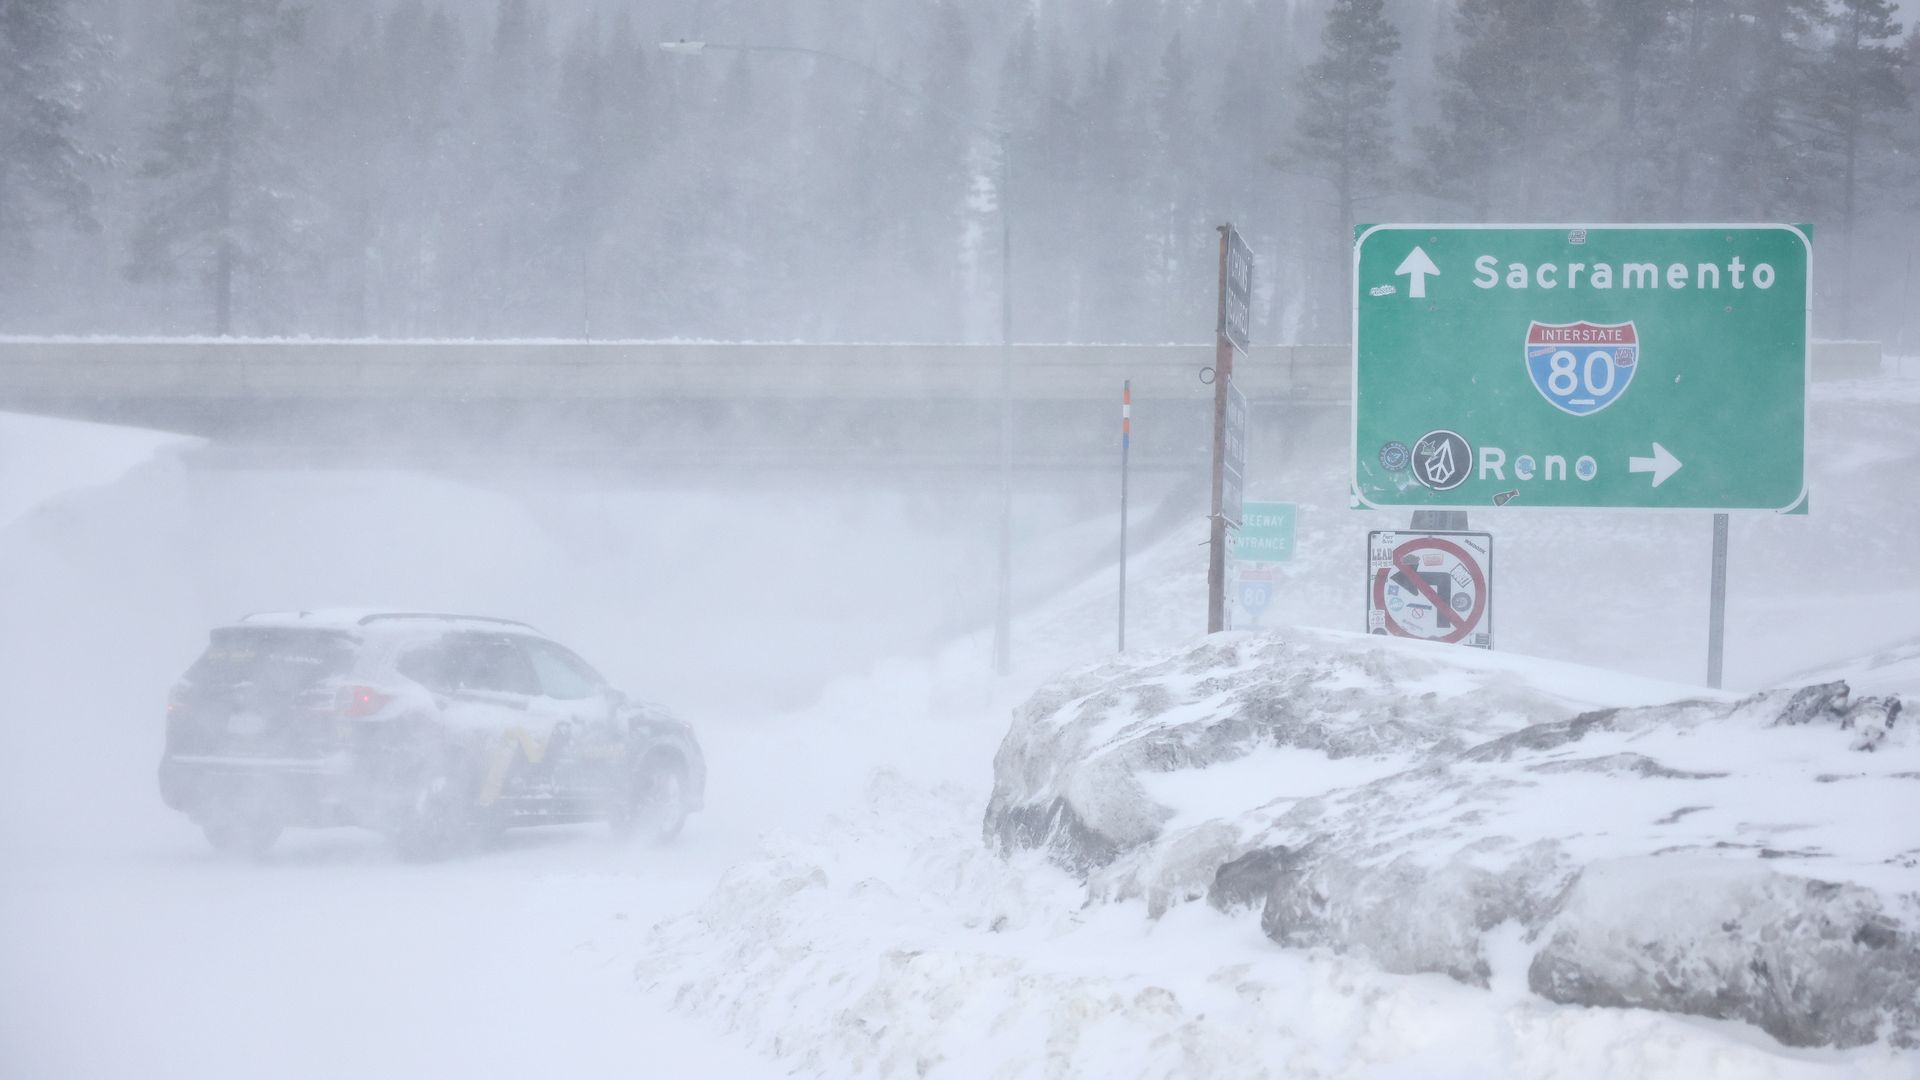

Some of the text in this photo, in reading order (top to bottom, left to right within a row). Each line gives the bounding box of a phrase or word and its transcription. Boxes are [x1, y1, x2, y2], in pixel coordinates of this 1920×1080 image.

[1472, 254, 1777, 290] Sacramento
[1541, 329, 1623, 341] INTERSTATE
[1547, 350, 1615, 396] 80
[1479, 446, 1599, 482] Reno
[1241, 514, 1285, 528] REEWAY
[1236, 536, 1286, 550] NTRANCE
[1243, 587, 1266, 607] 80
